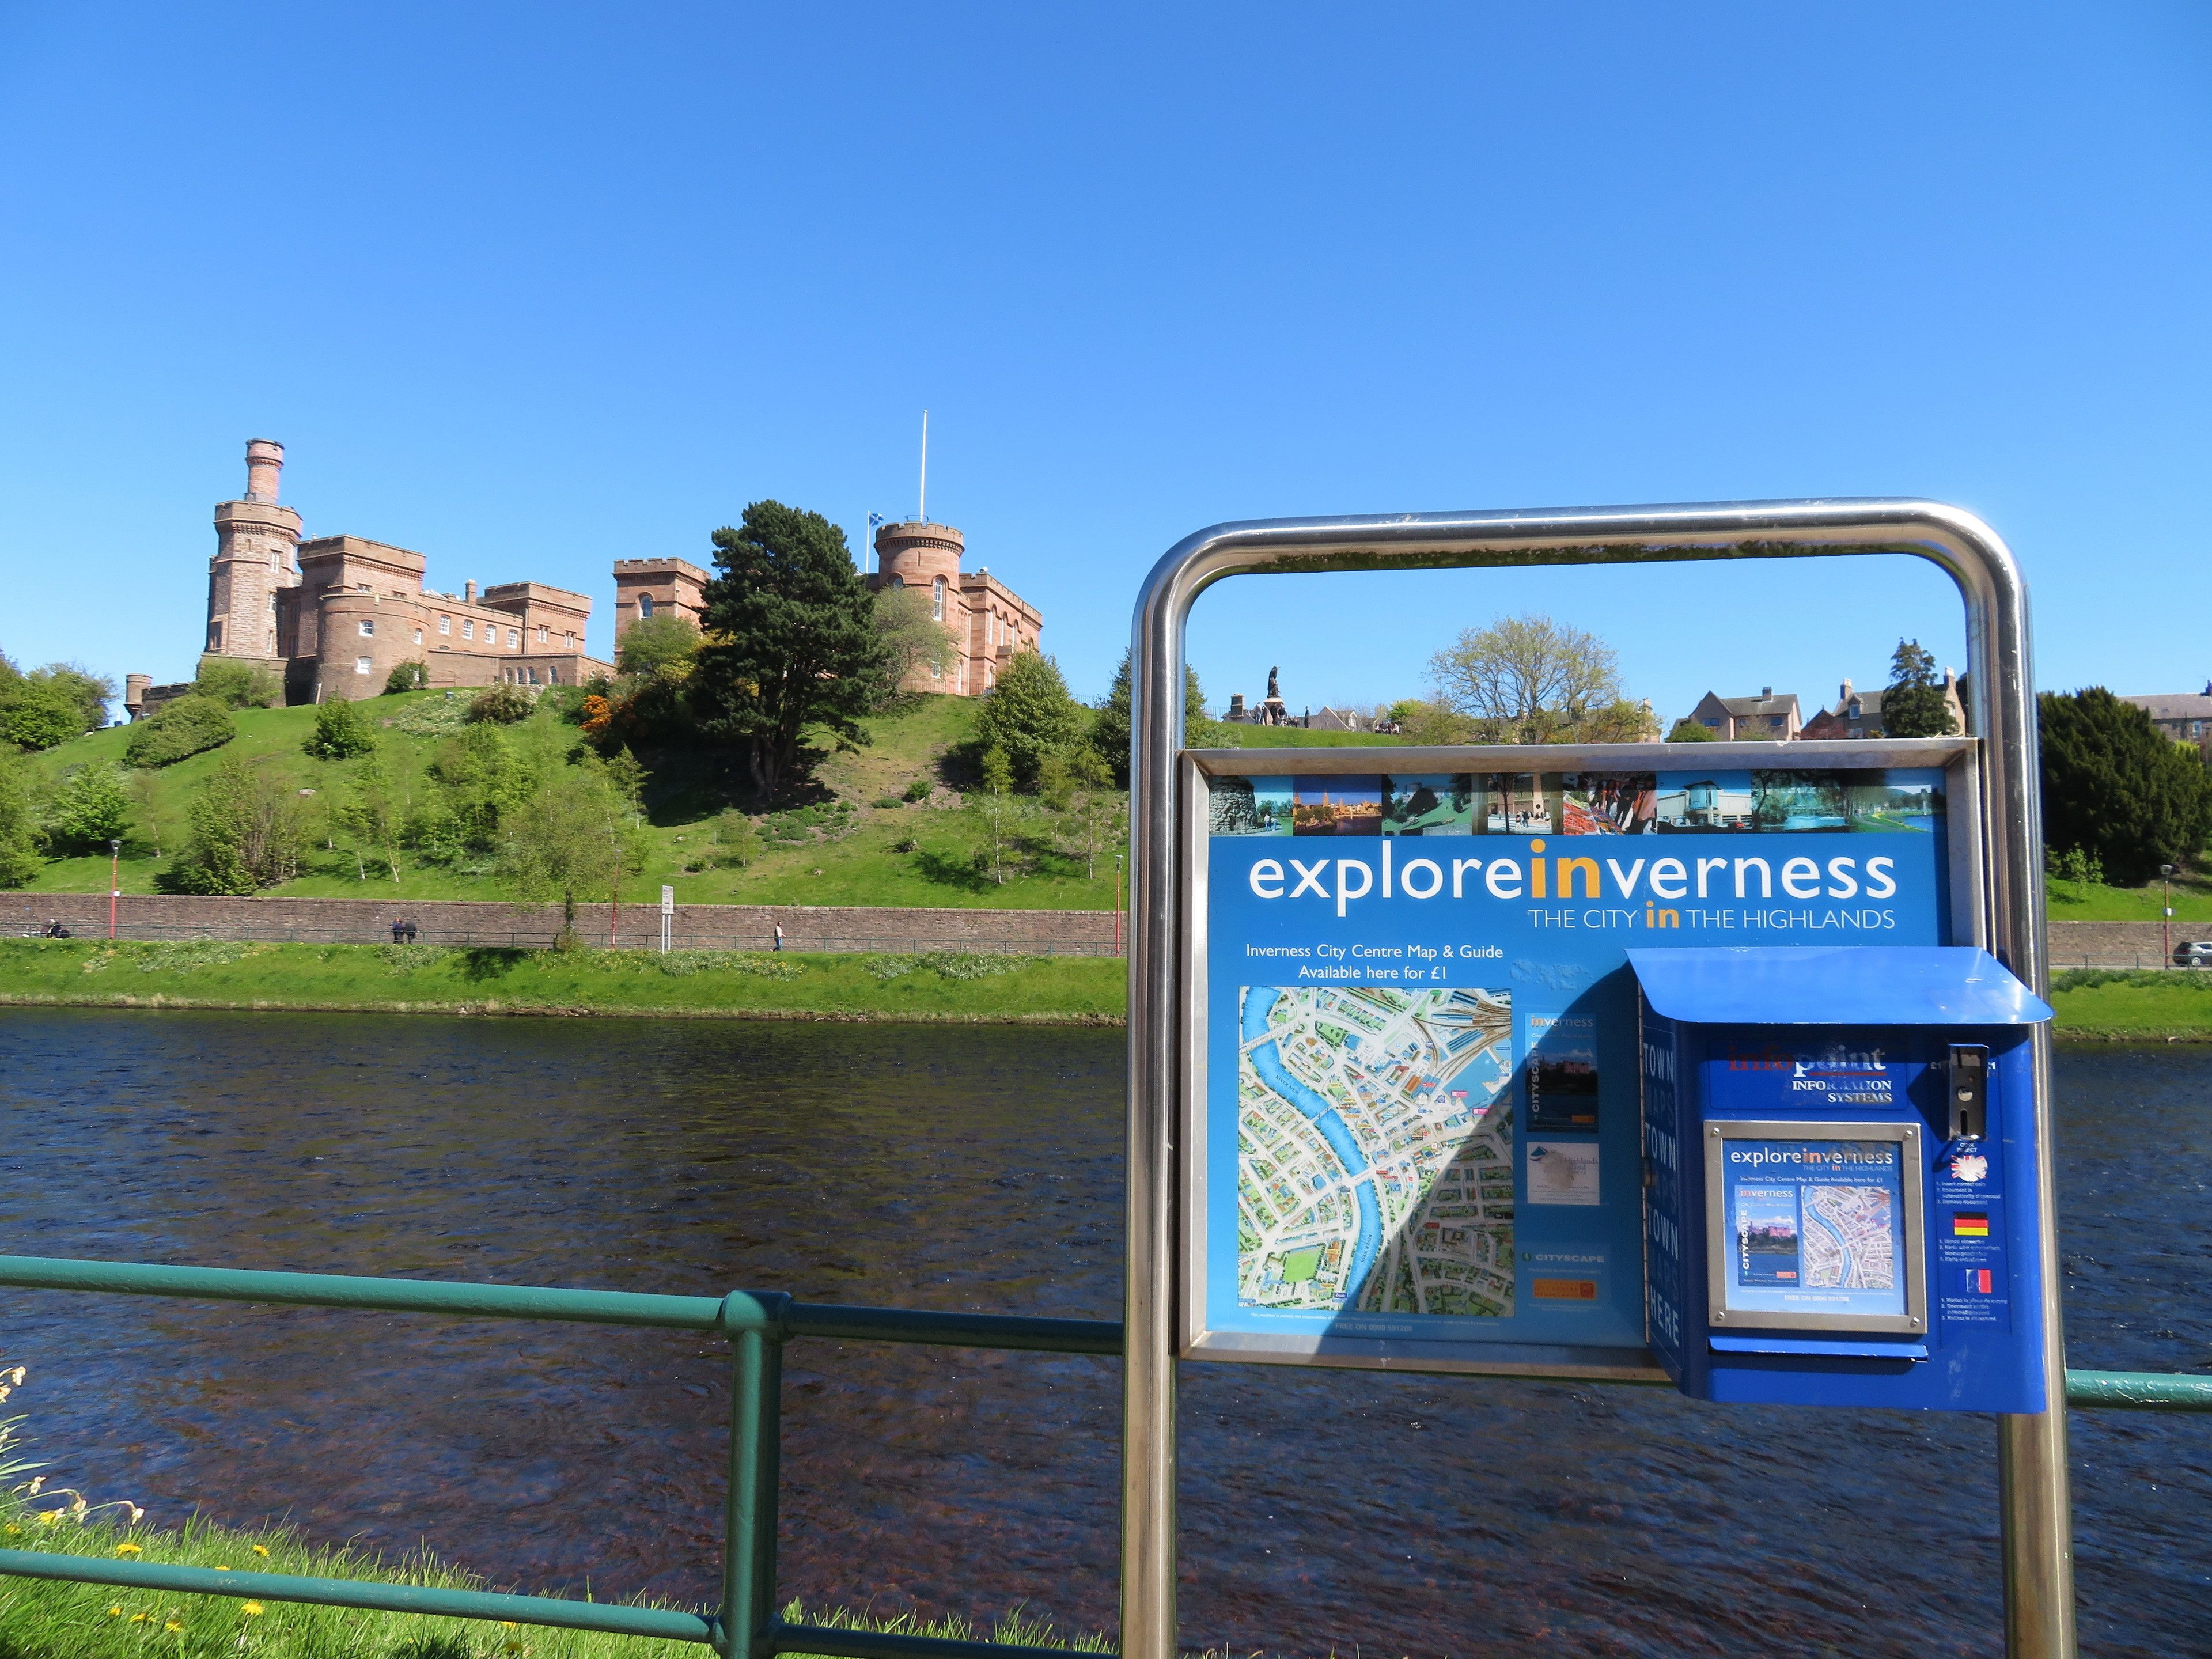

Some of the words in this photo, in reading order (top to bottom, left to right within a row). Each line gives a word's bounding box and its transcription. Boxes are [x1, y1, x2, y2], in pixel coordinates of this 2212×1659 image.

[1249, 839, 1897, 918] exploreinverness
[1528, 909, 1575, 929] THE
[1584, 909, 1639, 929] CITY
[1647, 900, 1679, 929] in
[1686, 910, 1734, 929] THE
[1744, 910, 1895, 929] HIGHLANDS
[1246, 944, 1311, 957] Inverness
[1316, 944, 1346, 961] City
[1351, 944, 1402, 958] Centre
[1407, 945, 1438, 961] Map
[1442, 945, 1455, 959] &
[1459, 945, 1503, 959] Guide
[1298, 965, 1361, 979] Available
[1366, 965, 1399, 979] here
[1403, 965, 1426, 980] for
[1430, 966, 1446, 980] £1
[1531, 1014, 1594, 1028] inverness
[1643, 1042, 1674, 1083] TOWN
[1729, 1043, 1887, 1077] infopoint
[1275, 1075, 1289, 1086] RIVER
[1289, 1085, 1300, 1095] NESS
[1531, 1041, 1540, 1113] CITYSCAPE
[1828, 1092, 1892, 1103] SYSTEMS
[1645, 1120, 1676, 1172] TOWN
[1730, 1147, 1893, 1168] exploreinverness
[1740, 1187, 1794, 1198] inverness
[1365, 1234, 1373, 1249] RIVER
[1647, 1202, 1679, 1260] TOWN
[1740, 1209, 1750, 1270] CITYSCAPE
[1360, 1250, 1368, 1263] NESS
[1535, 1253, 1605, 1263] CITYSCAPE
[1650, 1284, 1680, 1349] HERE
